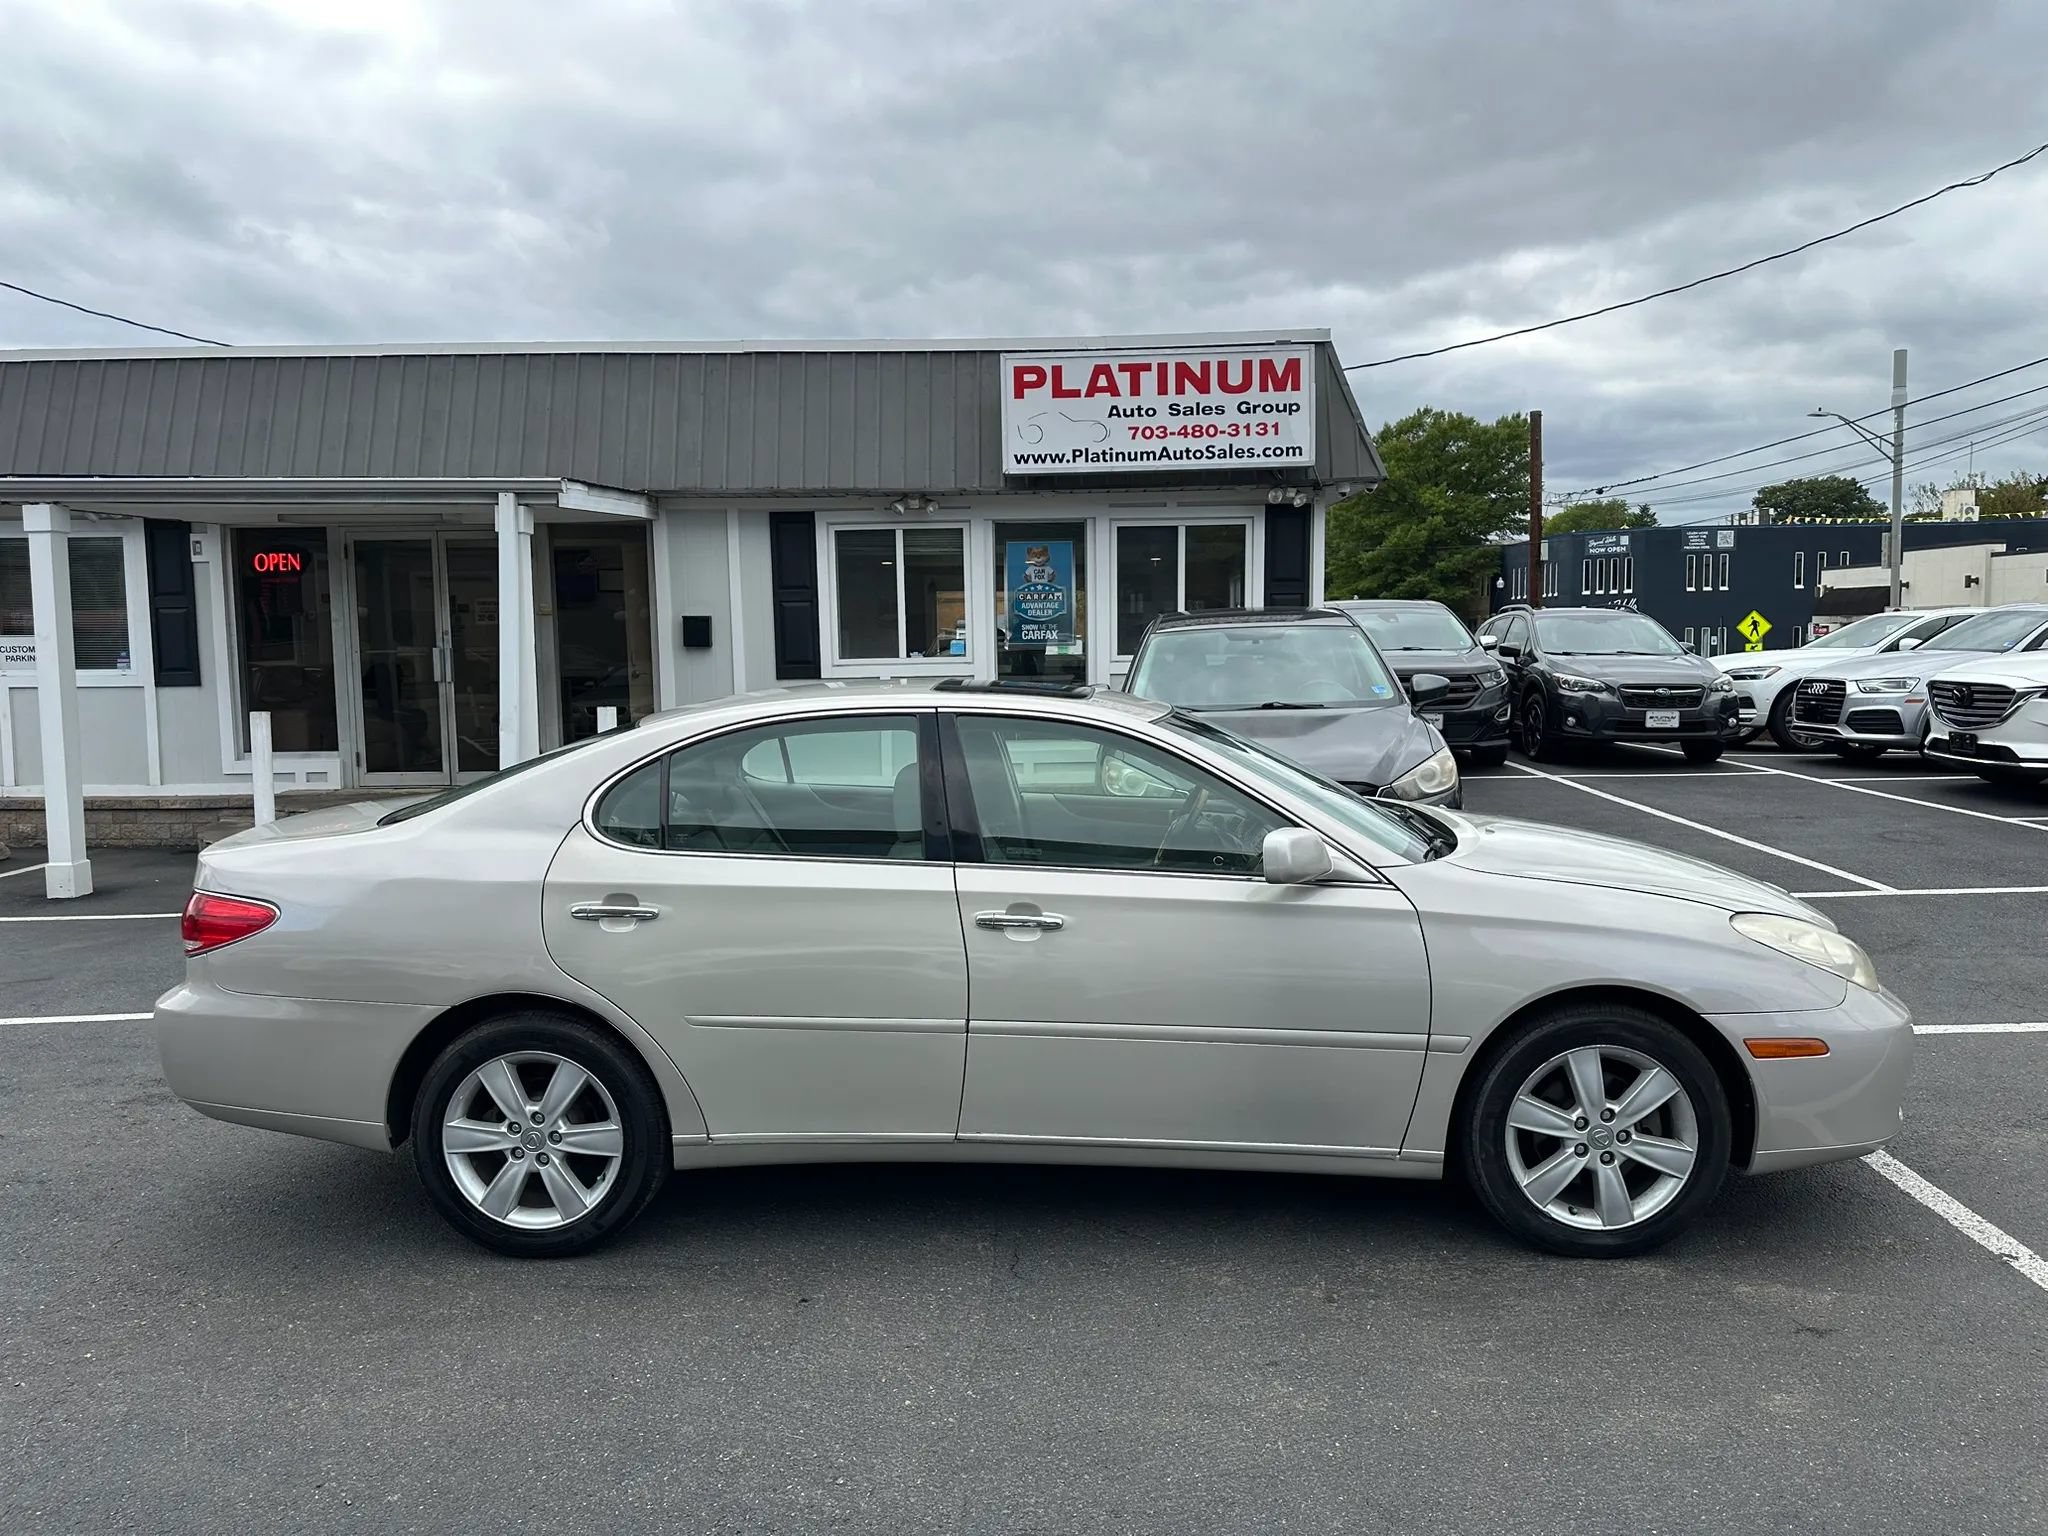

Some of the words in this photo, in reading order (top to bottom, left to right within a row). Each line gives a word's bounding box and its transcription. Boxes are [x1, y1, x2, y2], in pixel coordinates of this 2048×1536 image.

[1013, 358, 1302, 399] PLATINUM
[1107, 404, 1157, 418] Auto
[1168, 402, 1226, 416] Sales
[1237, 400, 1301, 416] Group
[1128, 422, 1281, 440] 703-480-3131
[1014, 443, 1303, 465] www.PlatinumAutoSales.com
[254, 553, 301, 572] OPEN
[1018, 593, 1063, 601] CARFAX
[1021, 630, 1058, 640] CARFAX
[0, 645, 36, 653] CUSTOM
